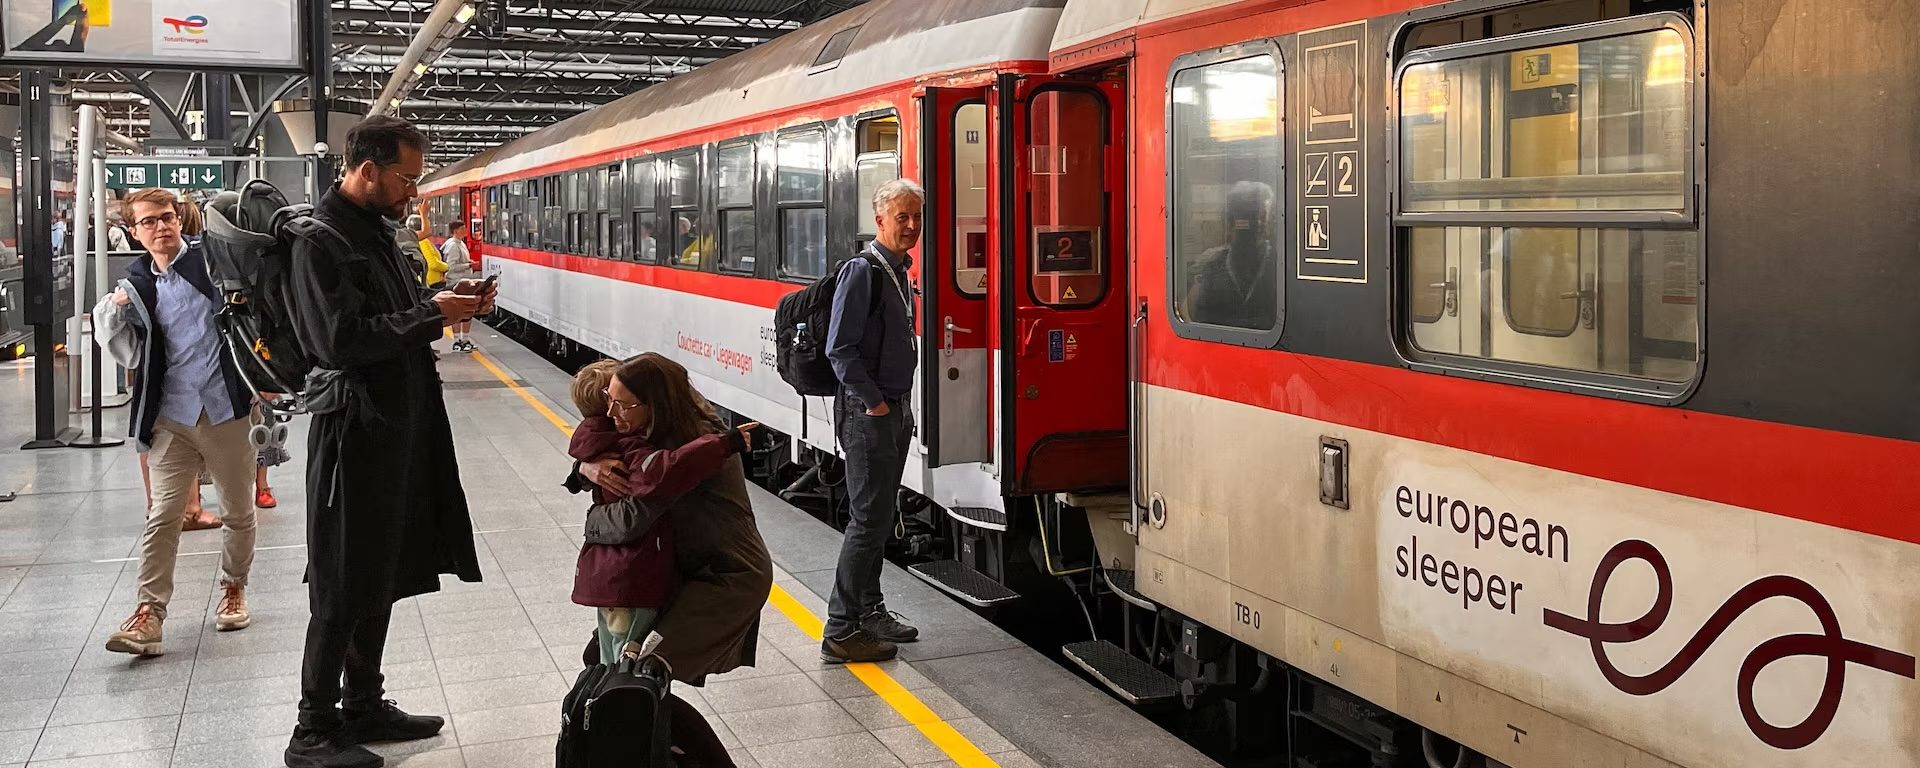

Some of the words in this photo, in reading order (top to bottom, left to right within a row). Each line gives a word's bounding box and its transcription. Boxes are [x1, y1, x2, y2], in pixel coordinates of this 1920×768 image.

[163, 36, 208, 44] TotalEnergies
[1339, 155, 1353, 192] 2
[1057, 236, 1073, 258] 2
[678, 330, 703, 356] Couchette
[704, 342, 712, 358] car
[716, 341, 753, 375] Liegewagen
[1396, 485, 1569, 563] european
[1396, 535, 1523, 615] sleeper
[1235, 601, 1251, 625] TB
